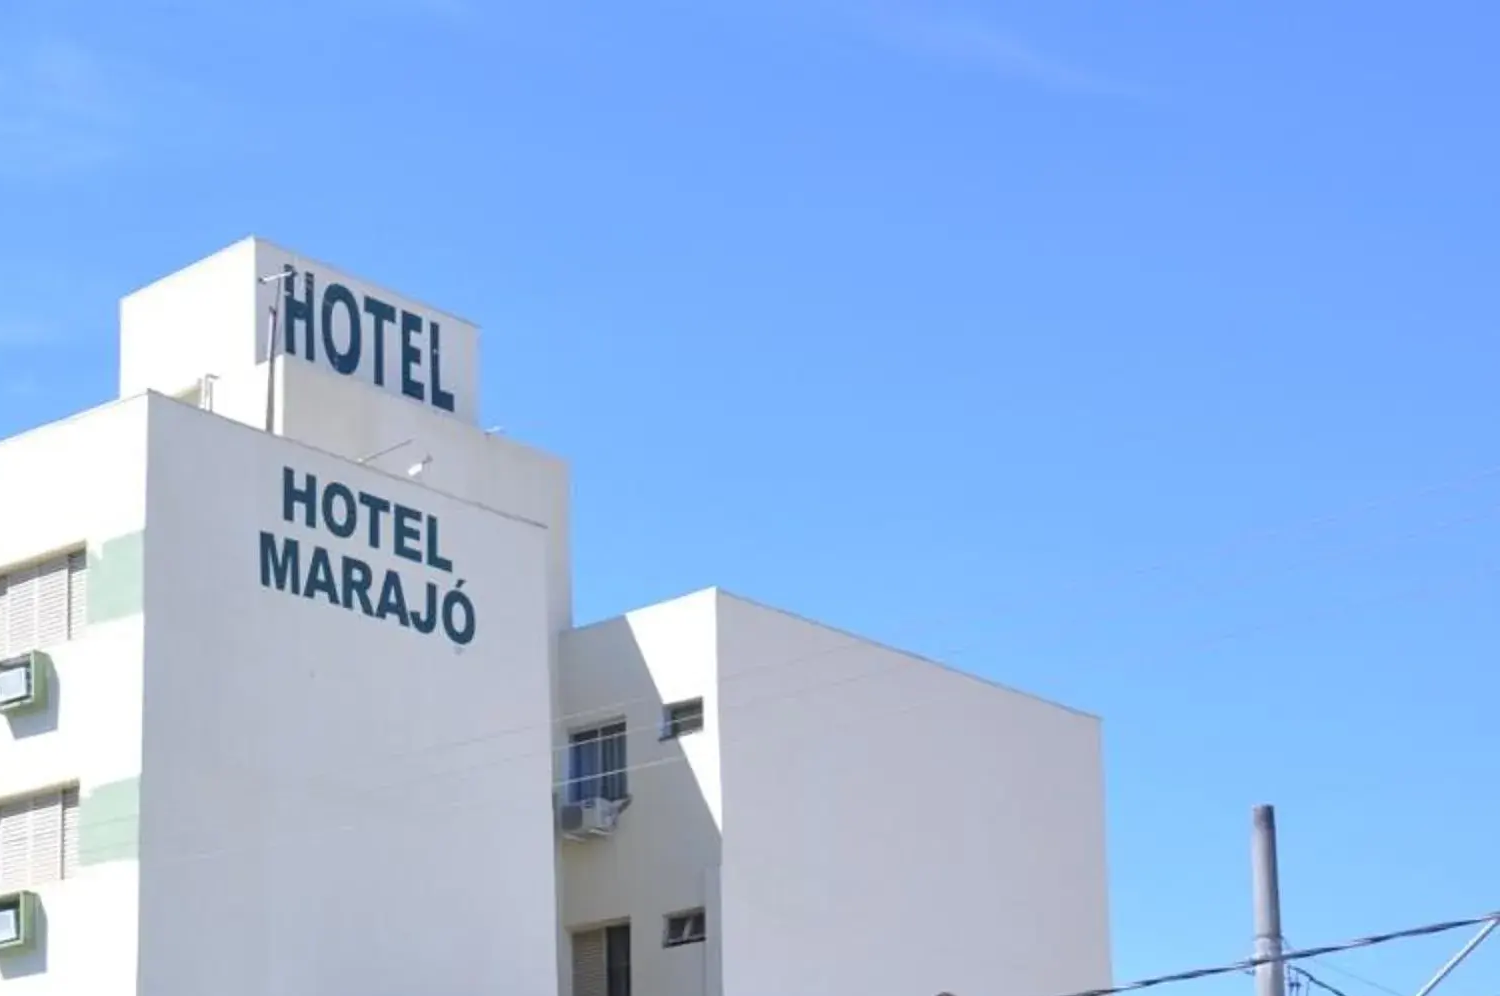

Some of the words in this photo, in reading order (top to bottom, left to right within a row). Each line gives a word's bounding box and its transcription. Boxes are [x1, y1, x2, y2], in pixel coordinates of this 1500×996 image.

[284, 264, 454, 412] HOTEL
[283, 466, 453, 573] HOTEL
[259, 530, 476, 645] MARAJÓ
